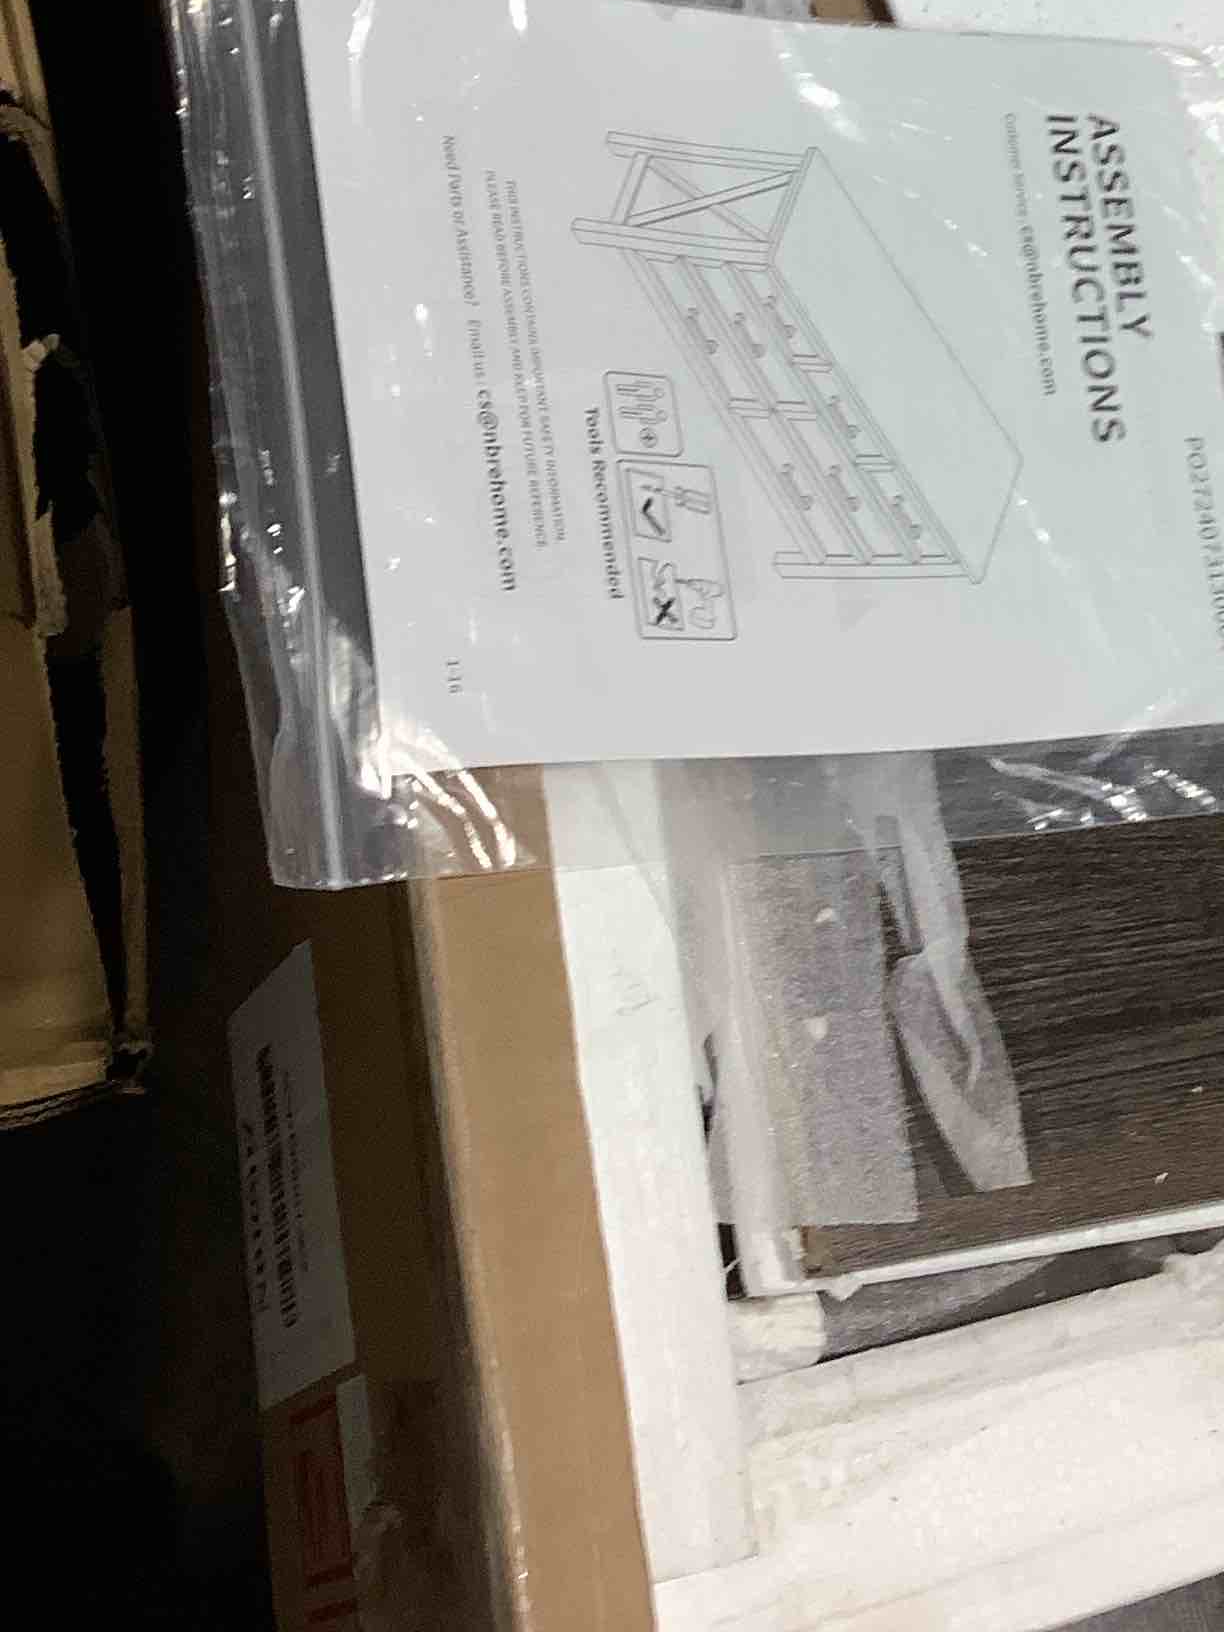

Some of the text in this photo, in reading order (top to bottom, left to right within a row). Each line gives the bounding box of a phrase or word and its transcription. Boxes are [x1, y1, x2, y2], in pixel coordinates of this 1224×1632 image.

[1017, 225, 1058, 397] cs@nbrehome.com
[1045, 114, 1127, 443] INSTRUCTIONS
[1085, 112, 1155, 338] ASSEMBLY
[476, 389, 517, 591] cs@nbrehome.com
[584, 408, 625, 600] Tools Recommended
